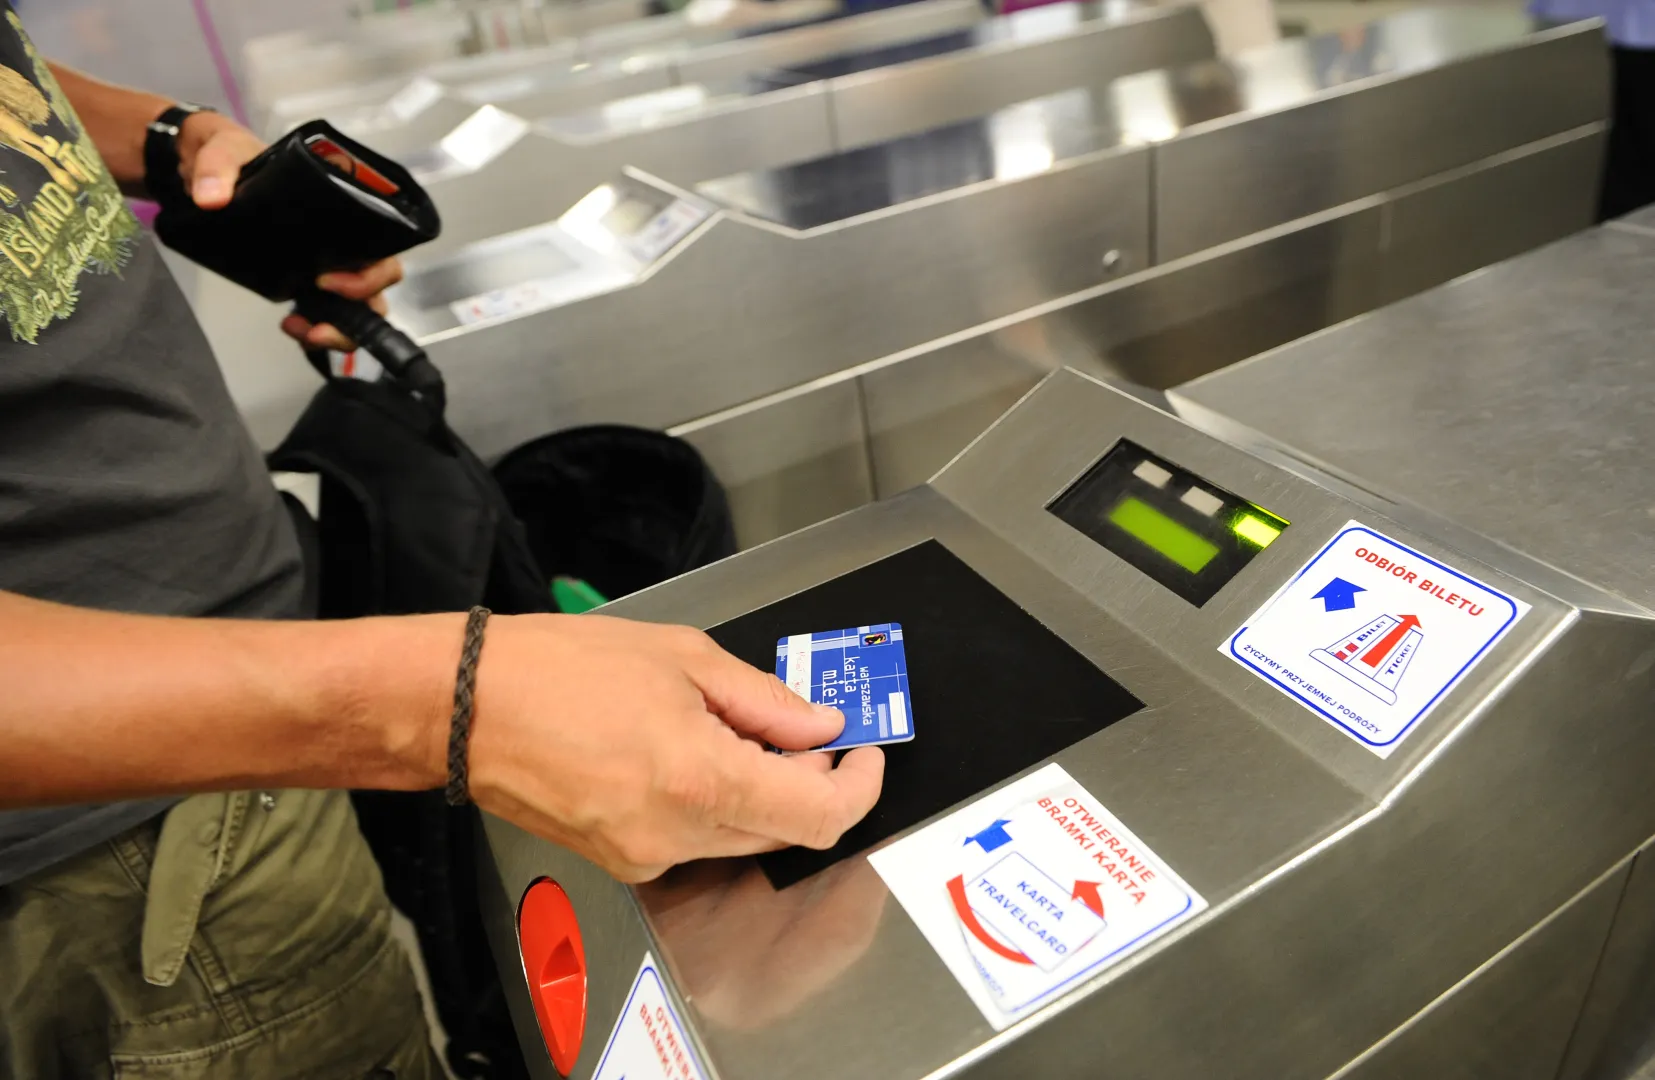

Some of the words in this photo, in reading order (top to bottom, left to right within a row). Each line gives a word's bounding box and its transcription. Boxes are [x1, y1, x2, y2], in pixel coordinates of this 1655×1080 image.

[0, 181, 76, 278] ISLAND
[1355, 546, 1419, 585] ODBIÓR
[1417, 579, 1485, 617] BILETU
[1356, 620, 1387, 642] BILET
[1384, 644, 1412, 675] TICKET
[844, 656, 861, 693] karta
[859, 666, 876, 726] warszawska
[1243, 644, 1282, 671] ŻYCZYMY
[1281, 668, 1338, 707] PRZYJEMNEJ
[1037, 797, 1095, 851] BRAMKI
[1063, 796, 1156, 882] OTWIERANIE
[976, 878, 1070, 956] TRAVELCARD
[1016, 880, 1065, 922] KARTA
